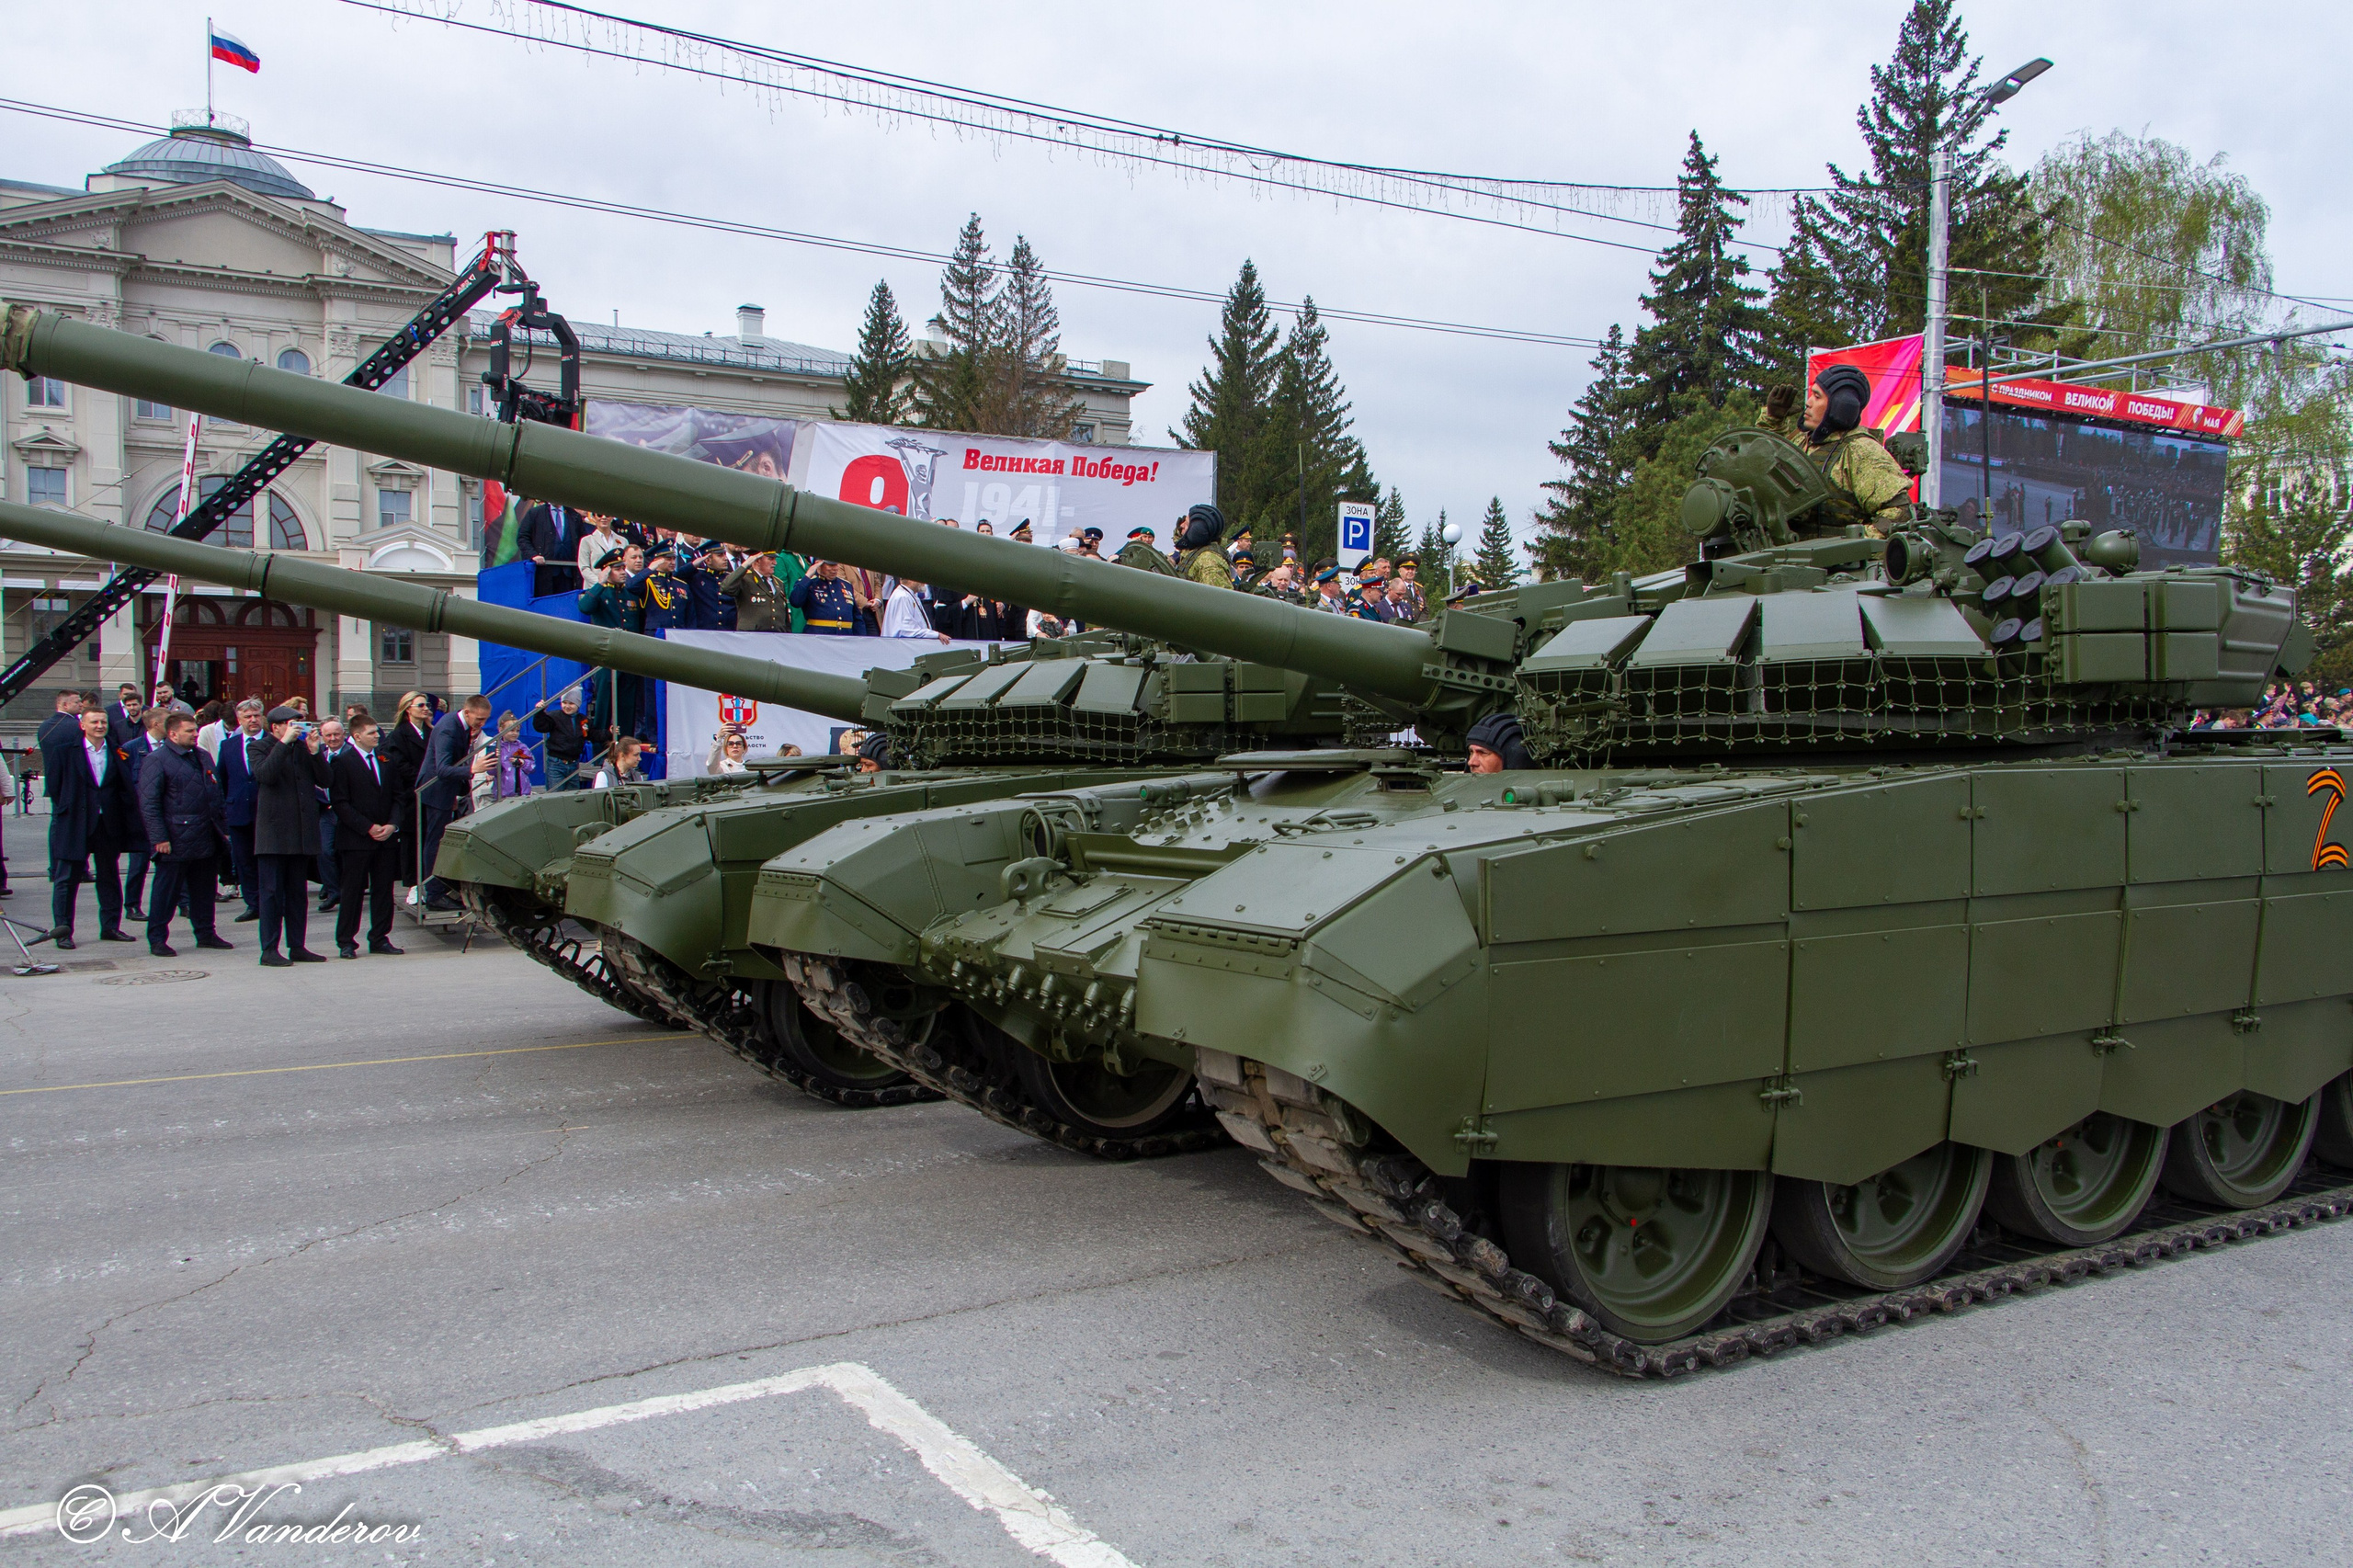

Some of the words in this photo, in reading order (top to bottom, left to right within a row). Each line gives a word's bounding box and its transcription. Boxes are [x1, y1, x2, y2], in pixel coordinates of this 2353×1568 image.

[1991, 384, 1998, 393] С
[1999, 385, 2052, 402] ПРАЗДНИКОМ
[2064, 392, 2115, 412] ВЕЛИКОЙ
[2128, 401, 2174, 420] ПОБЕДЫ!
[2203, 416, 2221, 428] МАЯ
[962, 448, 1065, 475] Великая
[1071, 455, 1159, 486] Победа!
[1346, 506, 1369, 516] ЗОНА
